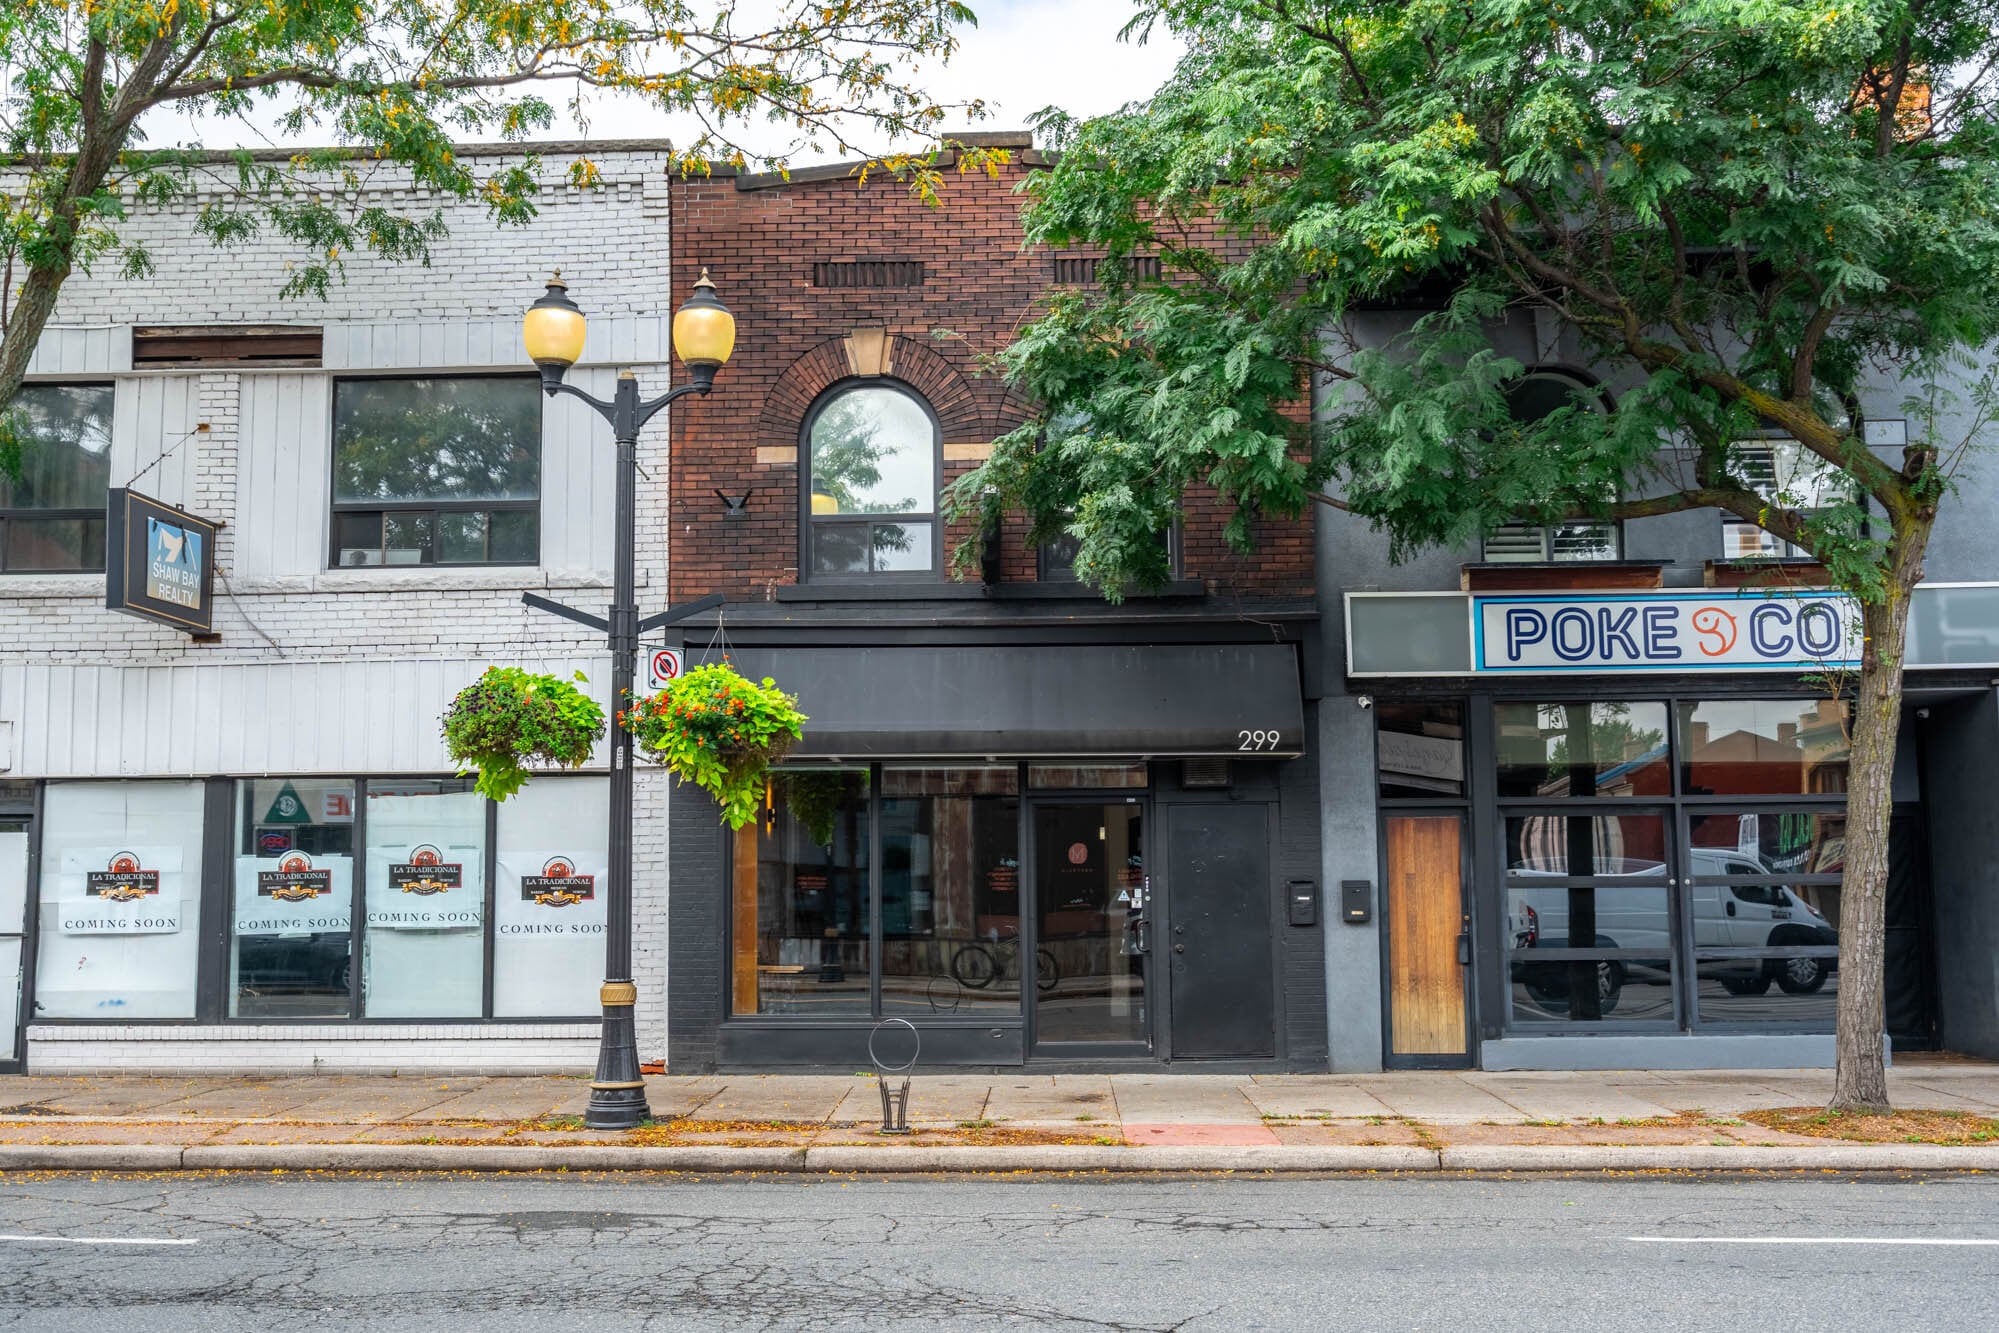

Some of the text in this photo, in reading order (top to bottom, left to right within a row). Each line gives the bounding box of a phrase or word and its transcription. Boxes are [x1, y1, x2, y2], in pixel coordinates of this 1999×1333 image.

[153, 561, 200, 589] SHAW BAY
[158, 583, 194, 606] REALTY
[1506, 602, 1842, 662] POKE CO
[1238, 730, 1280, 751] 299
[92, 872, 156, 881] LA TRADICIONAL
[262, 872, 328, 881] LA TRADICIONAL
[368, 912, 480, 922] COMING SOON
[65, 918, 177, 929] COMING SOON
[238, 918, 350, 929] COMING SOON
[500, 924, 564, 934] COMING
